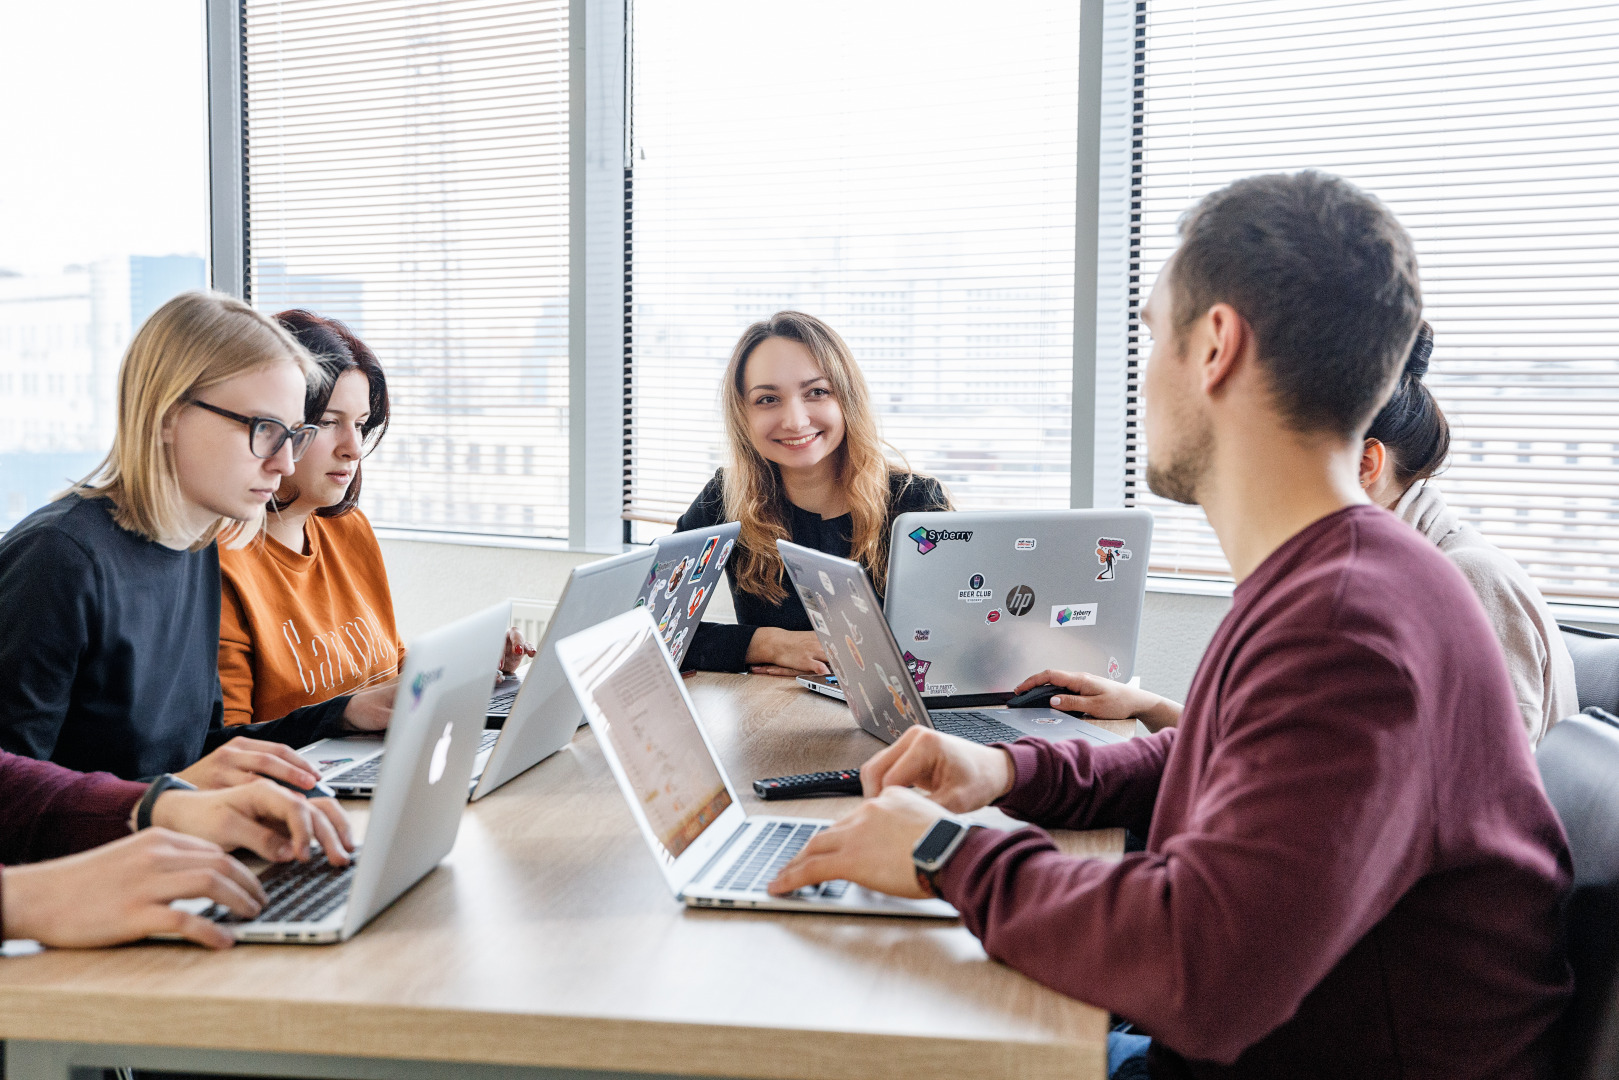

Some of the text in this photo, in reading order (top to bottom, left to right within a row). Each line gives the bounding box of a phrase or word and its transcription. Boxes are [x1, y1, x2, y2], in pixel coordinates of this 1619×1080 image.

[928, 530, 973, 542] Syberry
[959, 590, 974, 598] BEER
[1008, 585, 1033, 616] hp
[1073, 609, 1092, 617] Syberry
